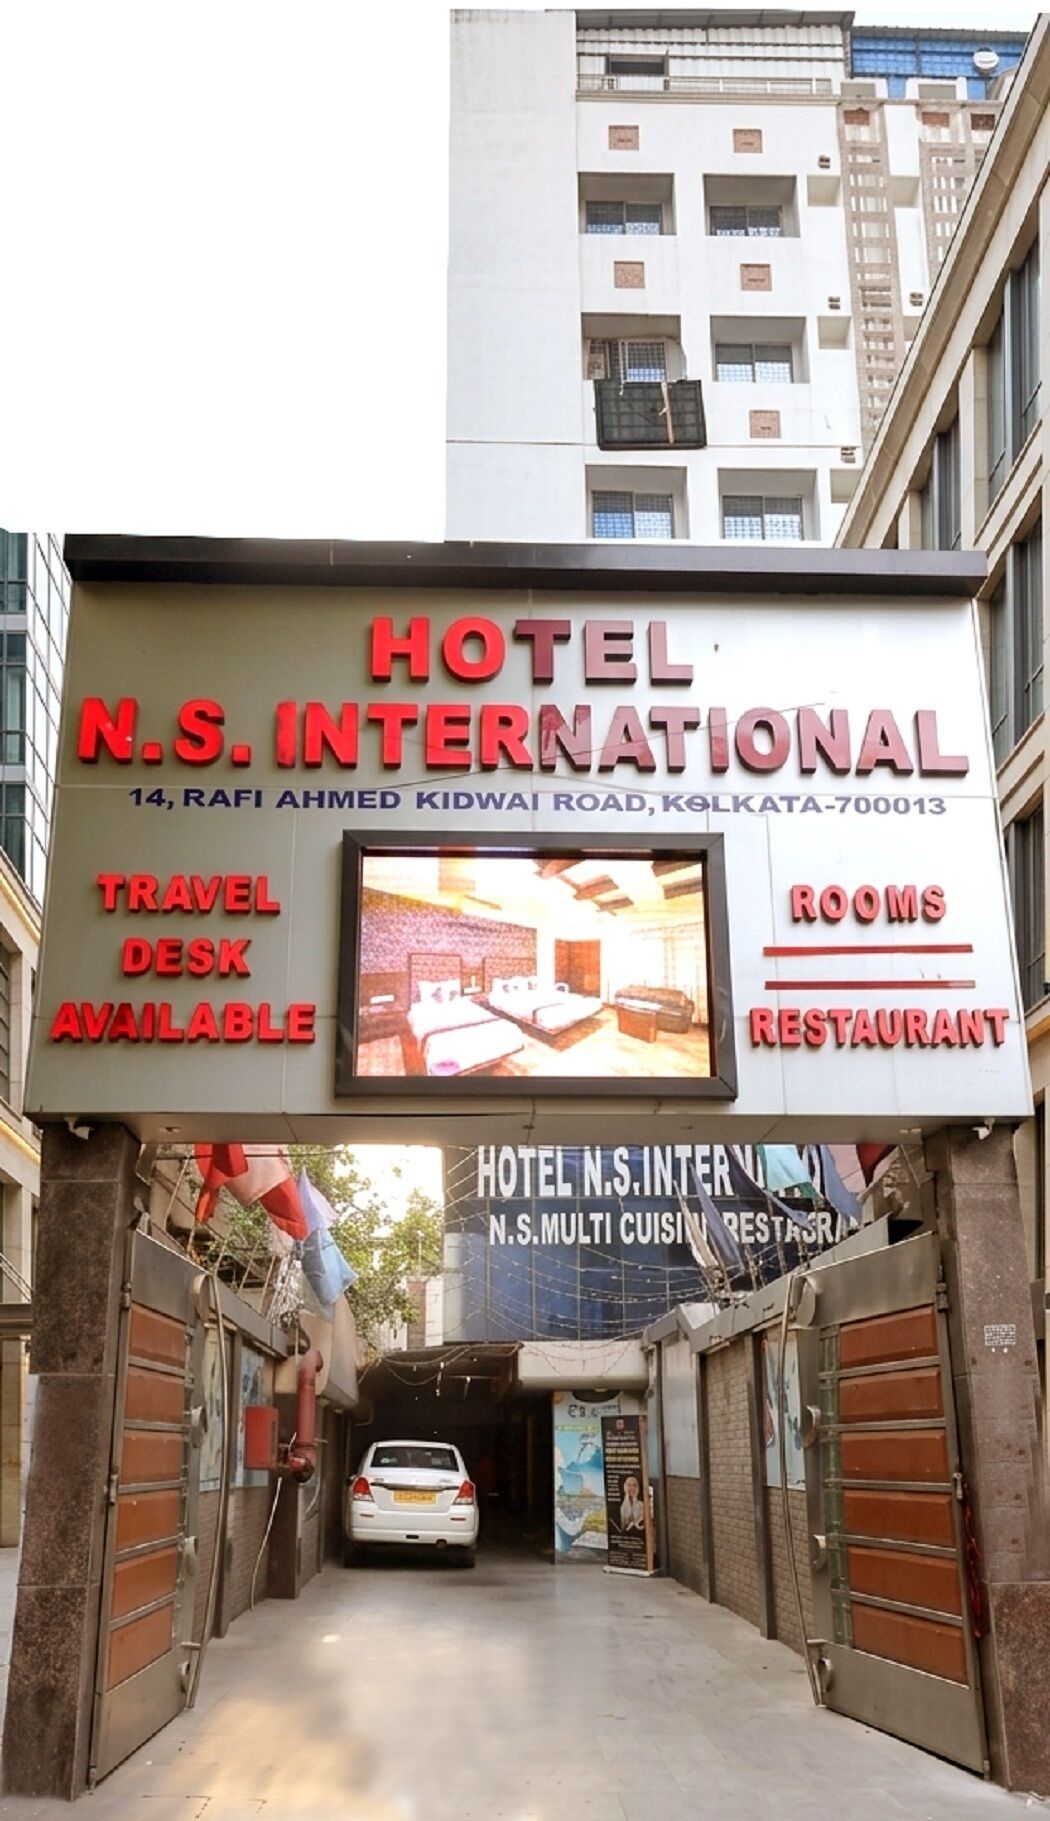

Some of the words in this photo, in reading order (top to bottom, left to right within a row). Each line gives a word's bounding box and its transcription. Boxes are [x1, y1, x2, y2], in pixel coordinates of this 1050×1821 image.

[370, 616, 693, 686] HOTEL
[77, 697, 251, 765] N.S.
[276, 700, 969, 777] INTERNATIONAL
[275, 790, 401, 809] AHMED
[416, 791, 539, 811] KIDWAI
[97, 874, 281, 914] TRAVEL
[790, 885, 947, 923] ROOMS
[122, 937, 252, 977] DESK
[50, 1002, 316, 1043] AVAILABLE
[750, 1007, 1010, 1048] RESTAURANT
[478, 1145, 573, 1198] HOTEL
